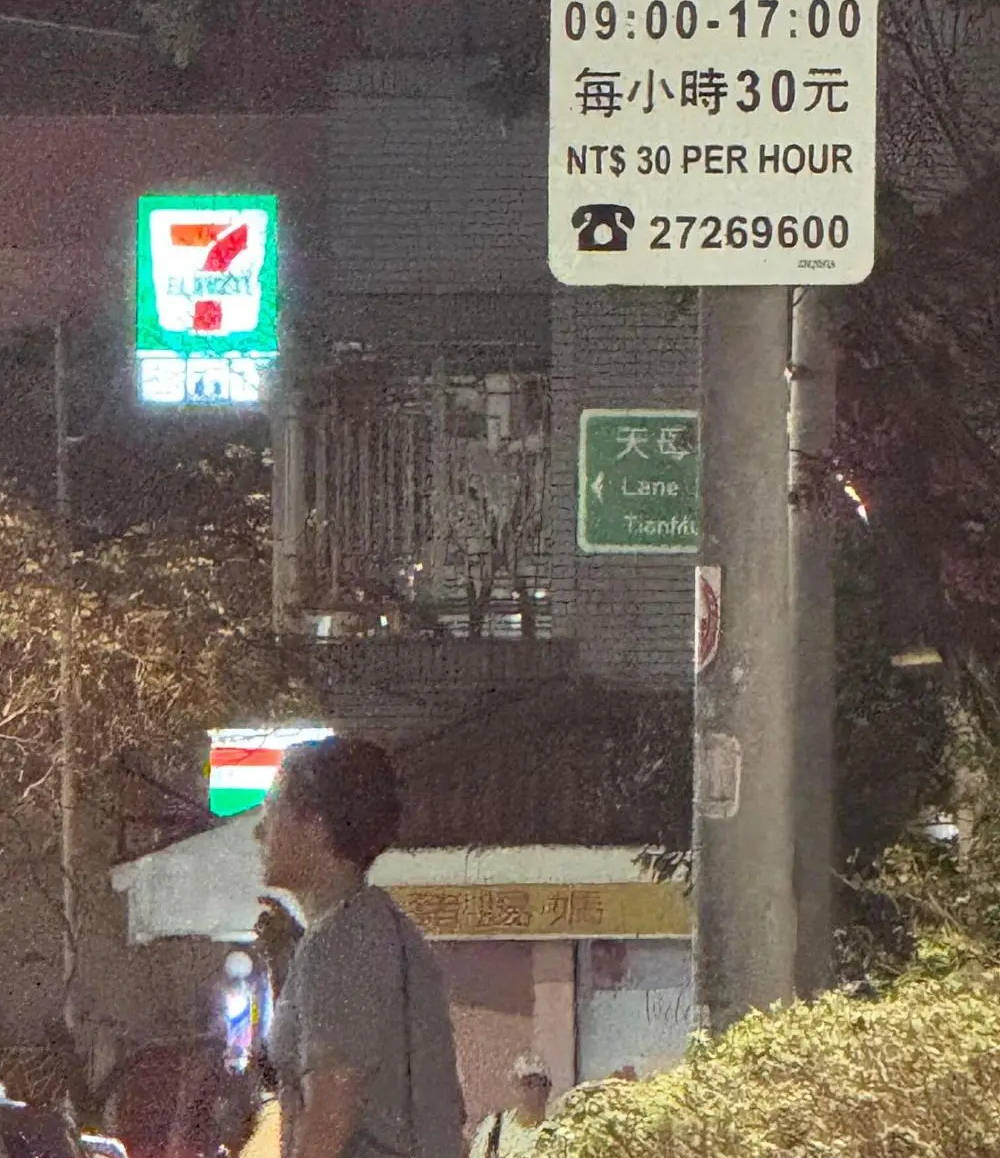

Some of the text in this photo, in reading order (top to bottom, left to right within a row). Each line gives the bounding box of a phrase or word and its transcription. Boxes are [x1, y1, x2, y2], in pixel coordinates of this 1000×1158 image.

[566, 0, 860, 40] 09:00-17:00
[575, 67, 848, 118] 每小時30元
[568, 144, 852, 177] NT$ 30 PER HOUR
[650, 215, 848, 249] 27269600
[622, 476, 680, 496] Lane
